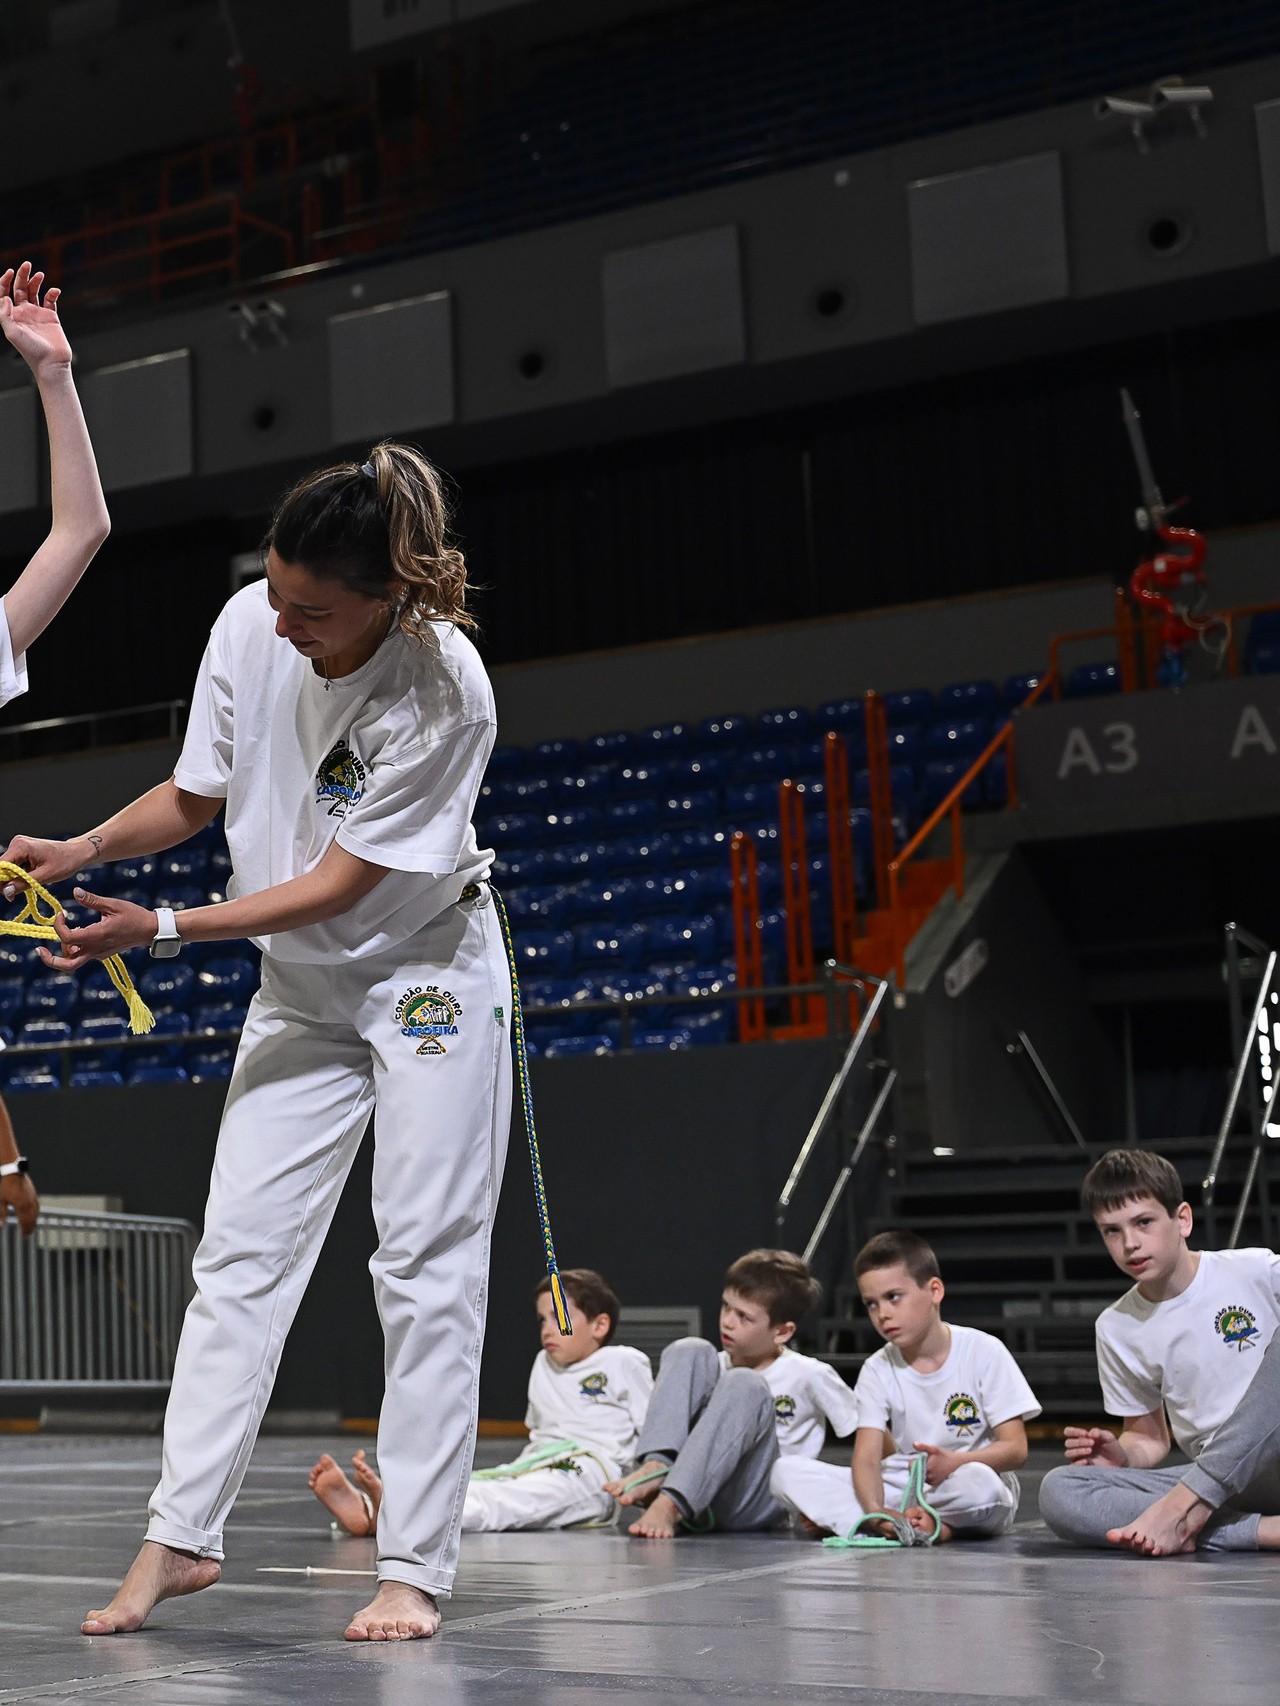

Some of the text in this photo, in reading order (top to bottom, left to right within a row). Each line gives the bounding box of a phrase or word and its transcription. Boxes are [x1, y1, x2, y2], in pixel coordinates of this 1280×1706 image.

[1230, 704, 1280, 760] A
[349, 750, 366, 781] OURO
[1056, 721, 1139, 780] A3
[394, 985, 463, 1020] CORDÃO DE OURO
[401, 1025, 459, 1037] CAPOEIRA
